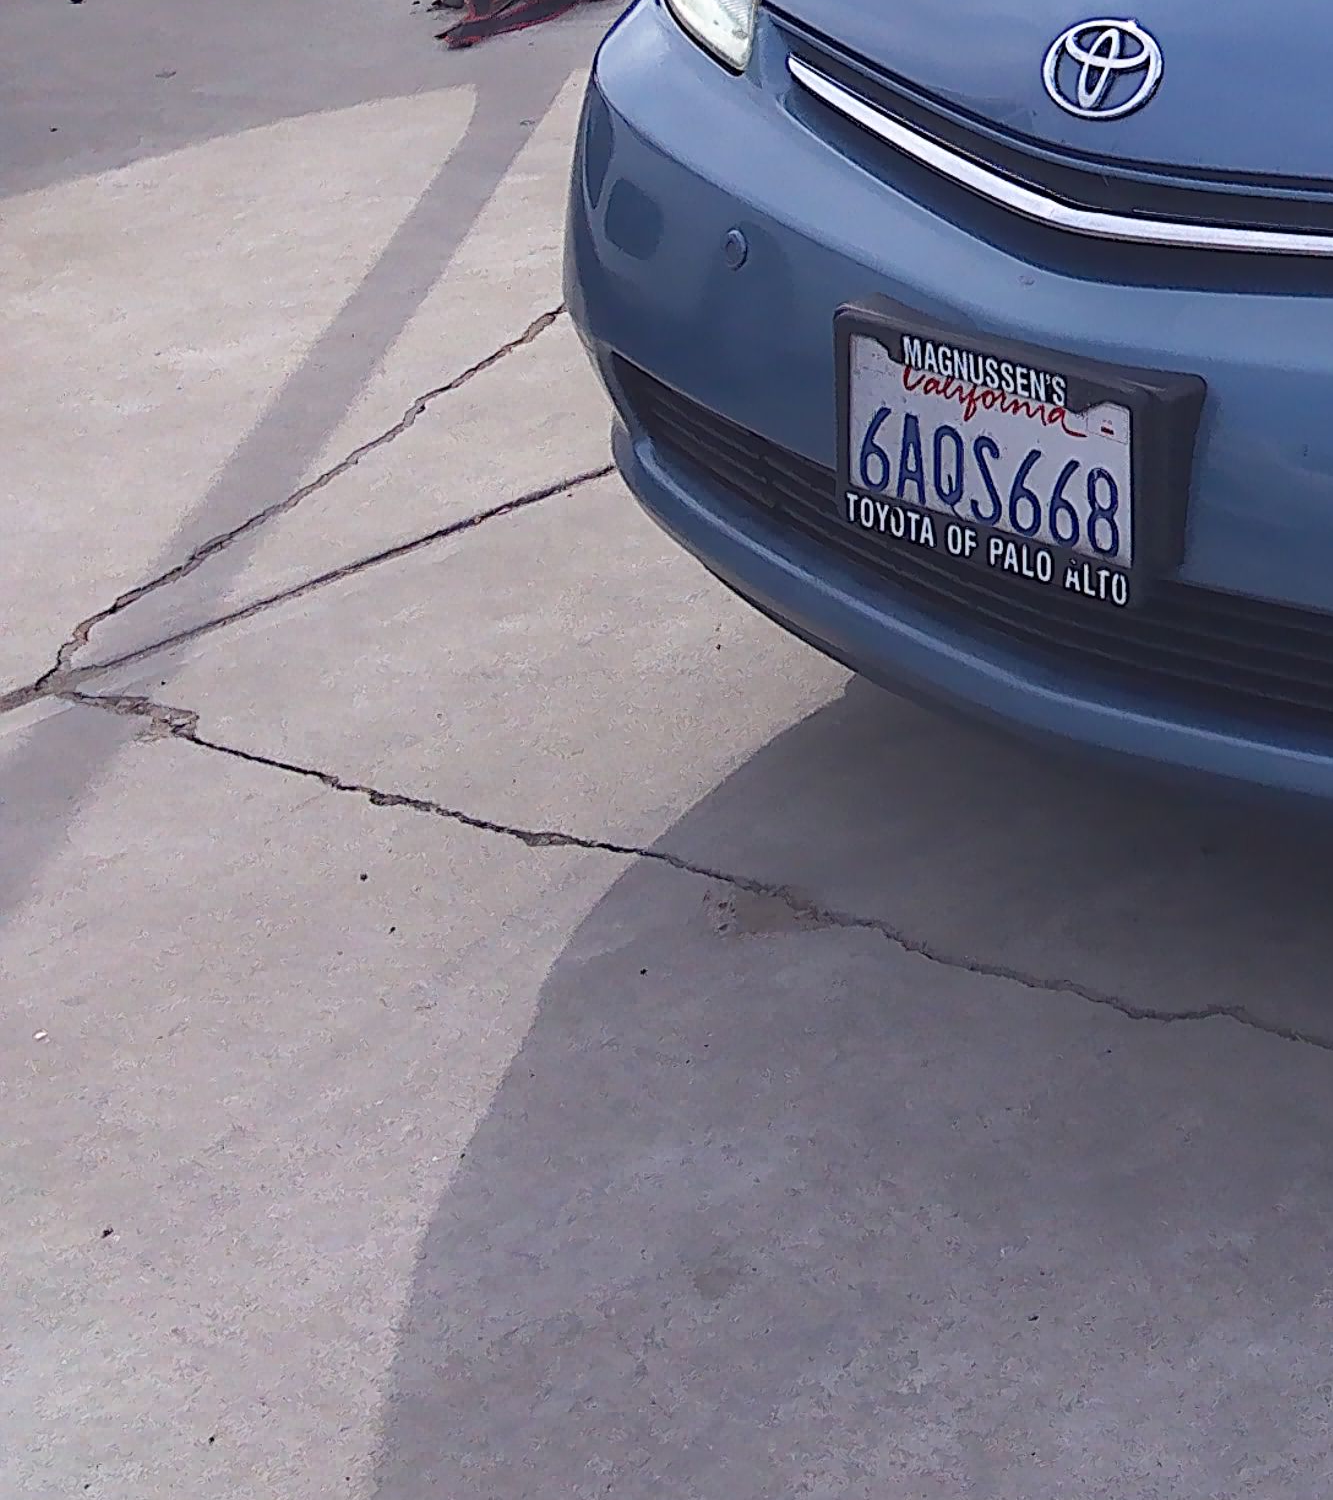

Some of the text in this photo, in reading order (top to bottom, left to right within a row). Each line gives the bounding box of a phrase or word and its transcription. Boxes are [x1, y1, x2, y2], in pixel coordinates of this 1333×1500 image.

[902, 335, 1067, 406] MAGNUSSEN'S
[859, 406, 1120, 558] 6AQS668
[845, 491, 1128, 606] TOYOTA OF PALO ALTO
